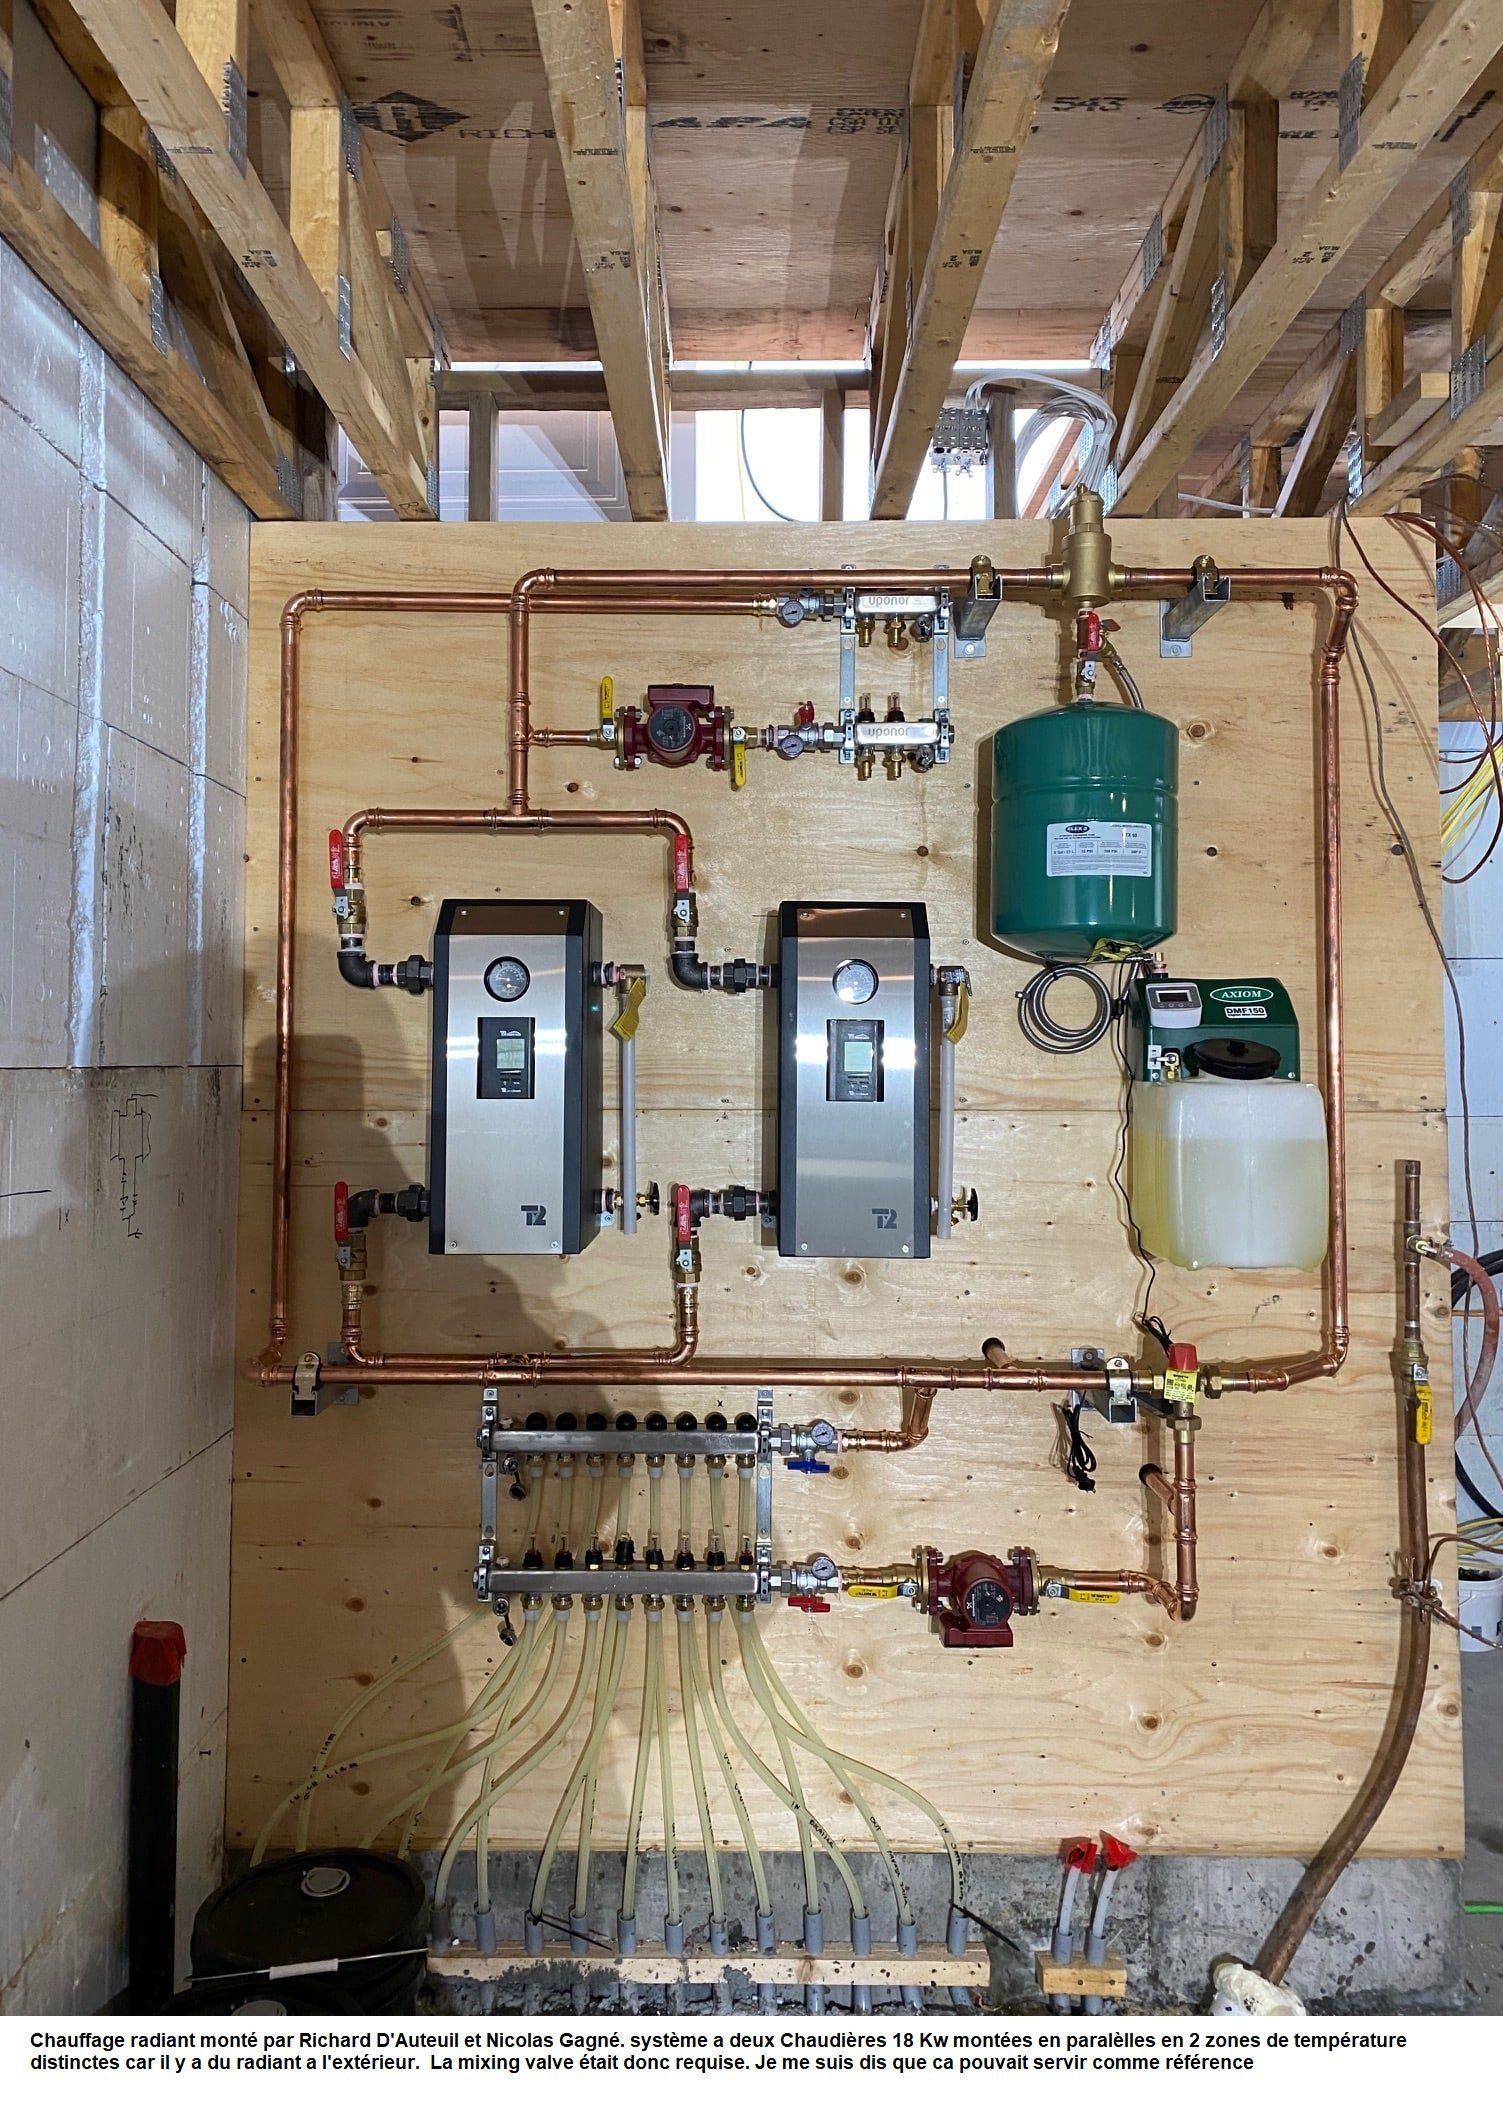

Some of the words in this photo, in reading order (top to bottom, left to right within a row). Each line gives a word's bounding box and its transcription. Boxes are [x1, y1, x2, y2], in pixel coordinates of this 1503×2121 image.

[1051, 96, 1128, 112] 543
[869, 596, 910, 606] uponor
[868, 728, 909, 738] uponor
[1221, 990, 1262, 998] AXIOM
[520, 1205, 546, 1226] T2
[872, 1208, 897, 1229] T2
[791, 1801, 800, 1810] IN
[869, 1816, 881, 1831] OUT
[938, 1823, 950, 1833] IN
